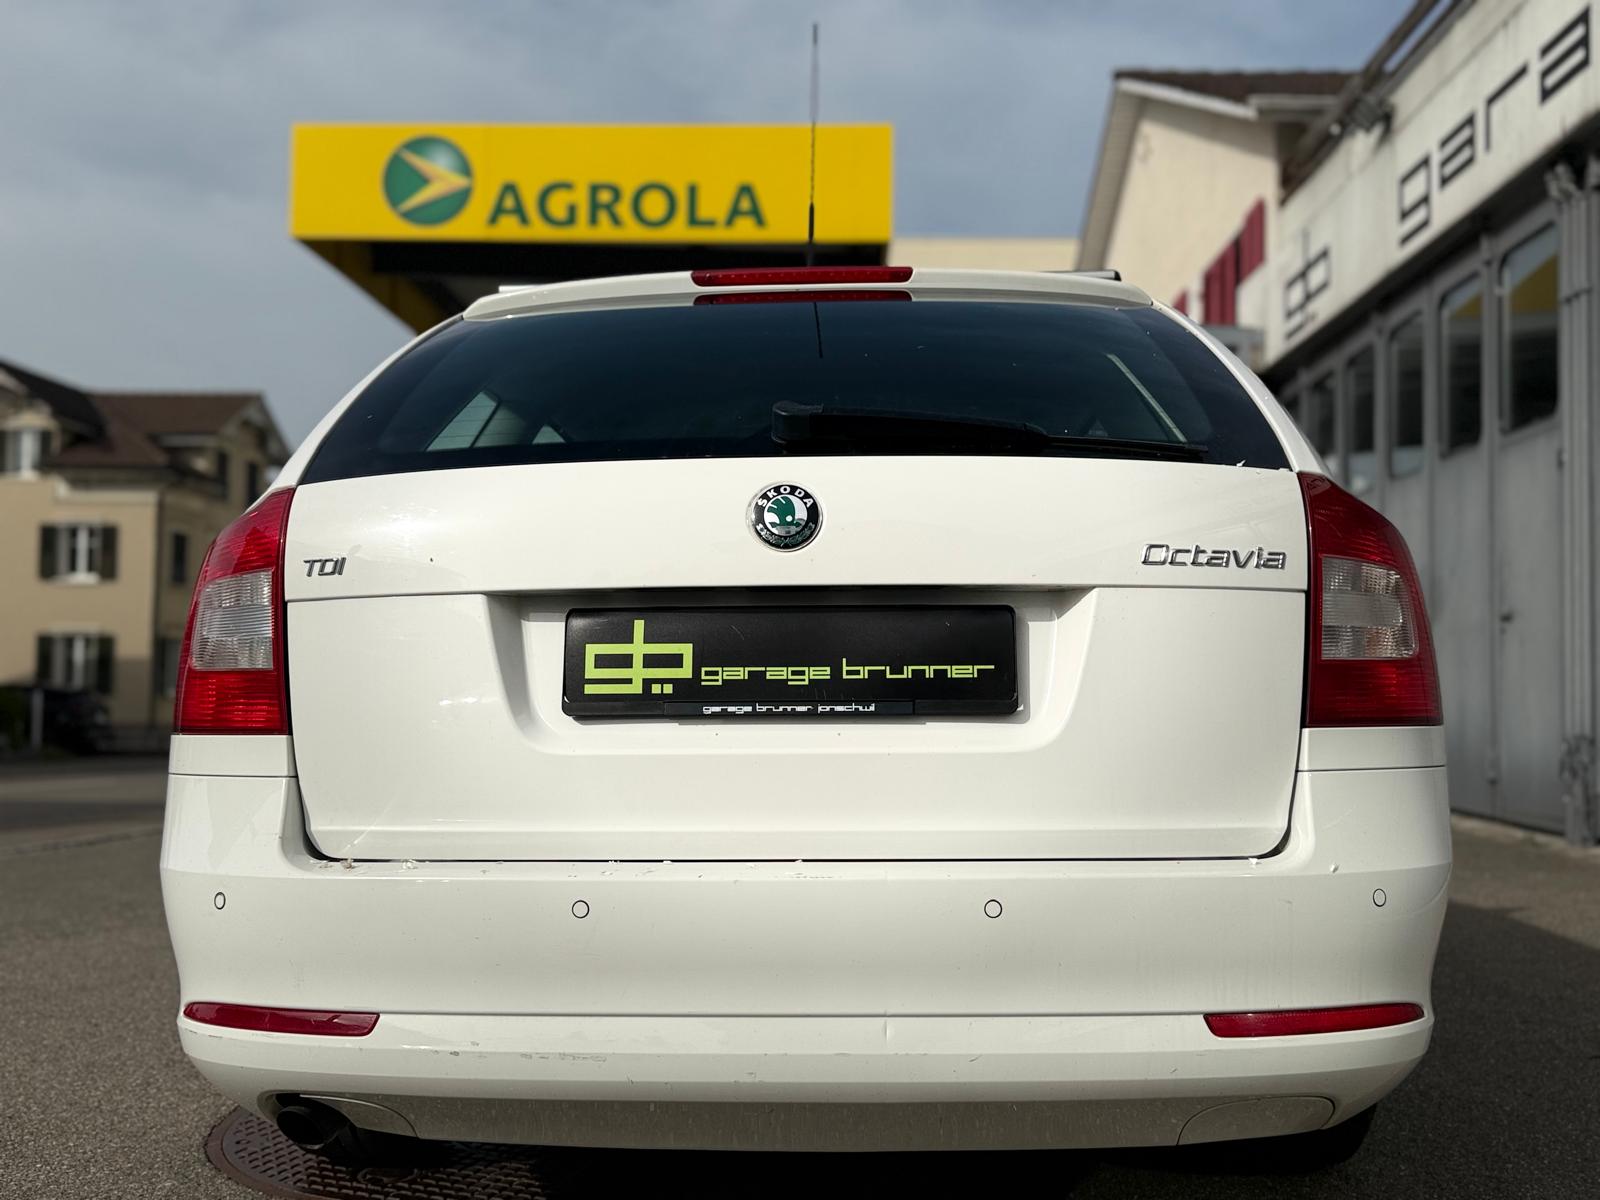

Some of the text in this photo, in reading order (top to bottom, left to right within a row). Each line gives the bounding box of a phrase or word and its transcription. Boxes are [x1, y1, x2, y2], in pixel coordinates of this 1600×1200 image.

[487, 181, 766, 229] AGROLA
[303, 556, 347, 577] TDI
[1140, 543, 1287, 570] Octavia
[700, 666, 831, 686] garage
[842, 658, 995, 680] brunner
[702, 705, 753, 715] garage
[756, 703, 813, 712] brunner
